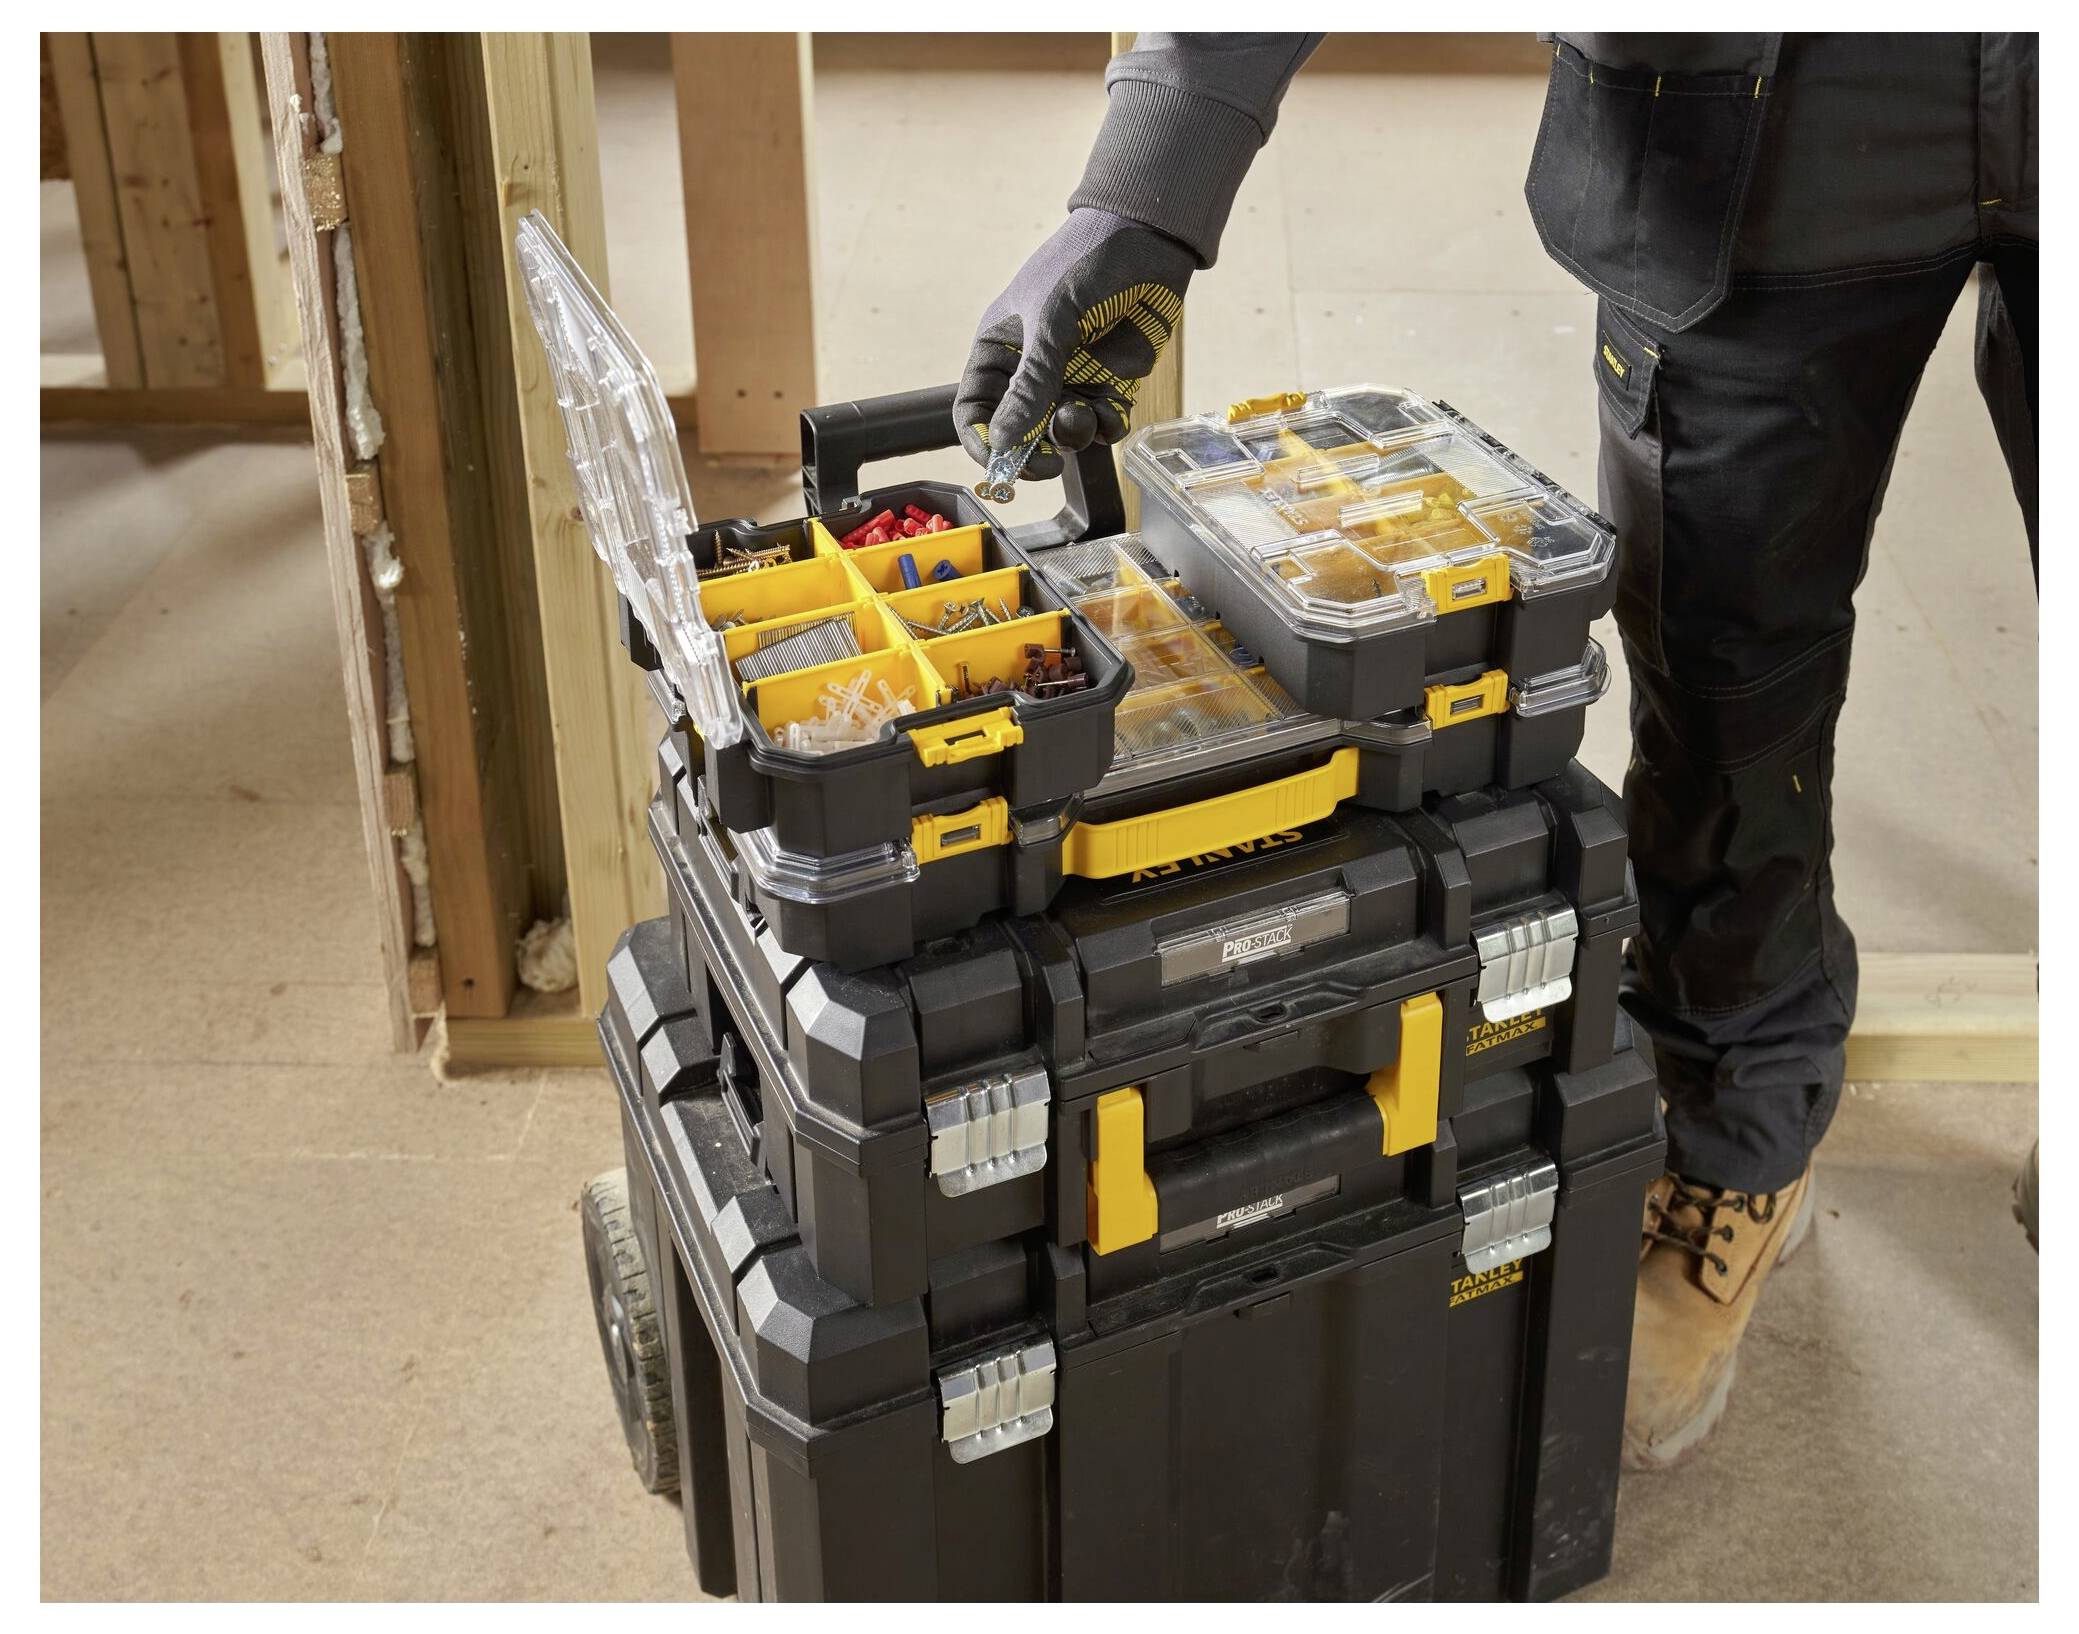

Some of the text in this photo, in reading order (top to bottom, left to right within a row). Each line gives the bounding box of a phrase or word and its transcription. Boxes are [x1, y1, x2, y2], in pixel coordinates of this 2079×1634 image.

[1222, 925, 1293, 959] PRO-STACK
[1466, 1021, 1536, 1055] FATMAX
[1450, 1257, 1522, 1293] TANLEY
